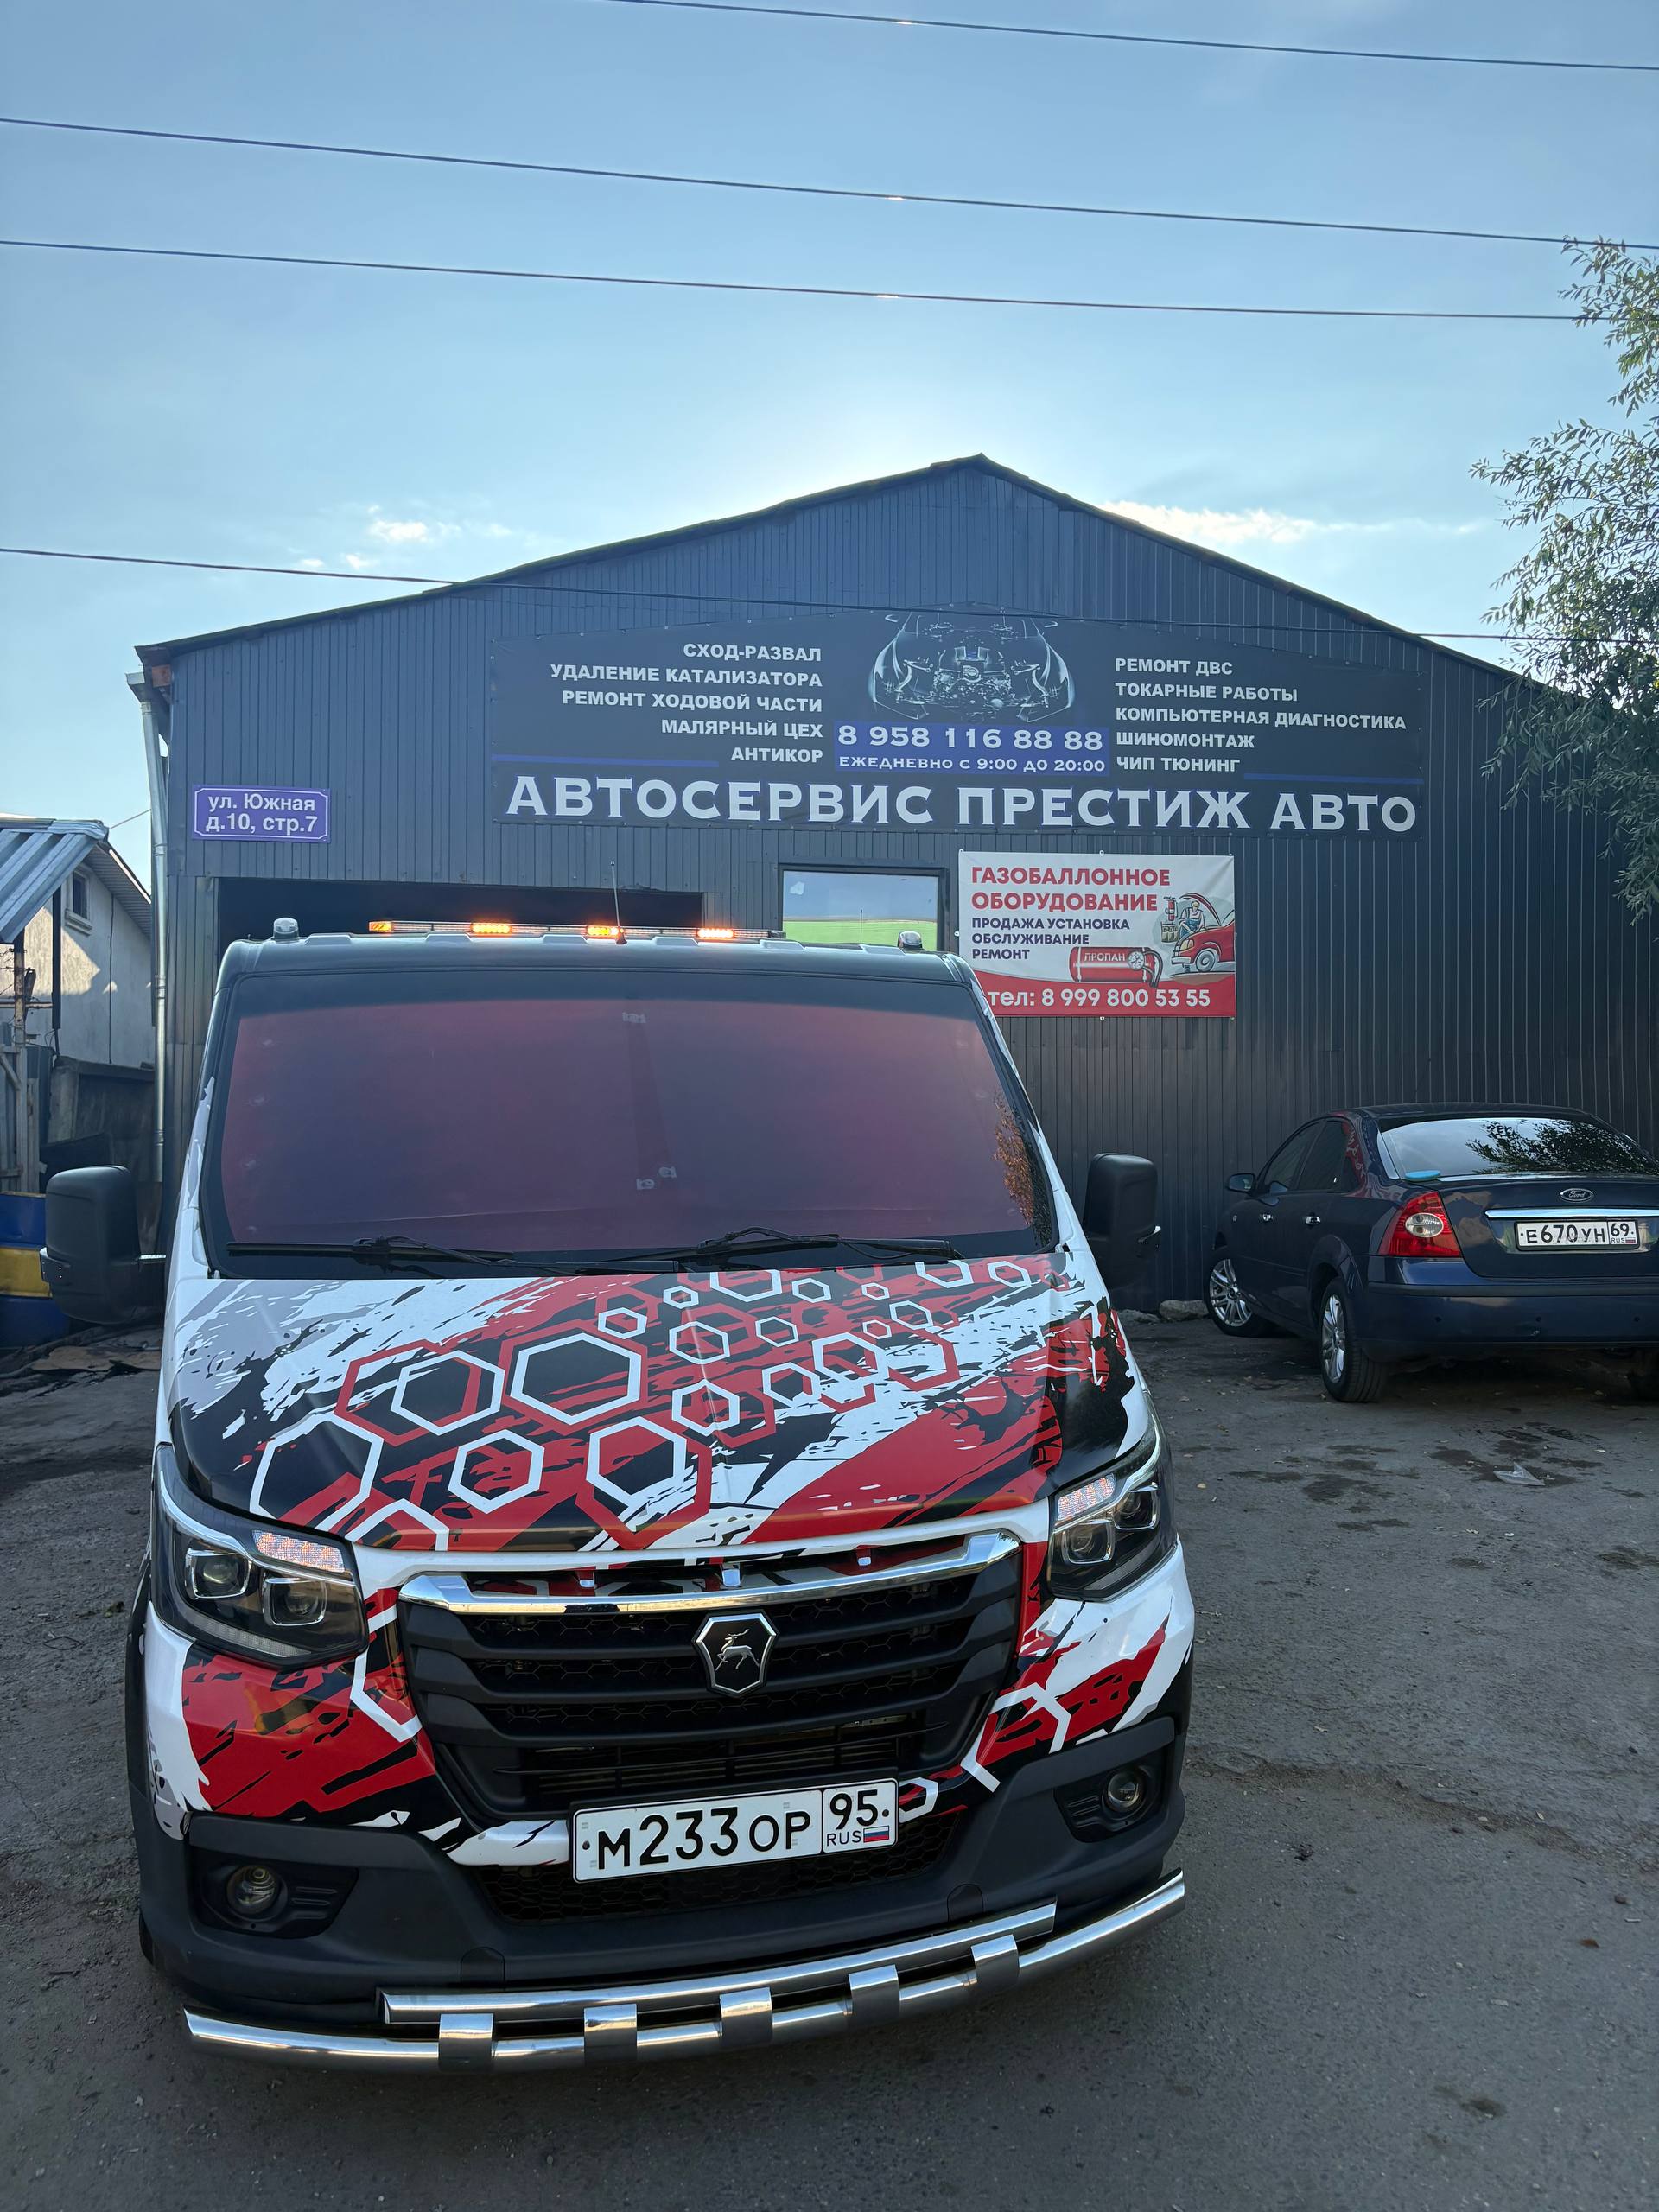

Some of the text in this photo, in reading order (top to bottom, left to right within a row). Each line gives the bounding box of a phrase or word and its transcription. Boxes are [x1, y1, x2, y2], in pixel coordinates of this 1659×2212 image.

[683, 643, 821, 662] СХОД-РАЗВАЛ
[550, 664, 822, 687] УДАЛЕНИЕ КАТАЛИЗАТОРА
[1116, 658, 1232, 676] РЕМОНТ ДВС
[1116, 683, 1297, 701] ТОКАРНЫЕ РАБОТЫ
[563, 690, 822, 713] РЕМОНТ ХОДОВОЙ ЧАСТИ
[1116, 708, 1407, 729] КОМПЬЮТЕРНАЯ ДИАГНОСТИКА
[661, 719, 823, 740] МАЛЯРНЫЙ ЦЕХ
[838, 725, 1103, 751] 8 958 116 88 88
[1116, 733, 1255, 749] ШИНОМОНТАЖ
[731, 747, 823, 764] АНТИКОР
[839, 756, 953, 769] ЕЖЕДНЕВНО
[977, 759, 1018, 770] 9:00
[1053, 760, 1105, 772] 20:00
[1116, 756, 1240, 772] ЧИП ТЮНИНГ
[207, 793, 315, 812] ул. Южная
[505, 775, 1416, 833] АВТОСЕРВИС ПРЕСТИЖ АВТО
[206, 813, 318, 836] д.10, стр.7
[971, 867, 1170, 886] ГАЗОБАЛЛОННОЕ
[971, 892, 1158, 912] ОБОРУДОВАНИЕ
[972, 918, 1129, 931] ПРОДАЖА УСТАНОВКА
[972, 932, 1090, 944] ОБСЛУЖИВАНИЕ
[972, 949, 1029, 959] РЕМОНТ
[1084, 951, 1125, 962] ПРОПАН
[988, 989, 1211, 1007] тел: 8 999 800 53 55
[1568, 1189, 1586, 1198] Ford
[1611, 1223, 1630, 1237] 69
[830, 1789, 878, 1830] 95
[826, 1830, 861, 1847] RUS
